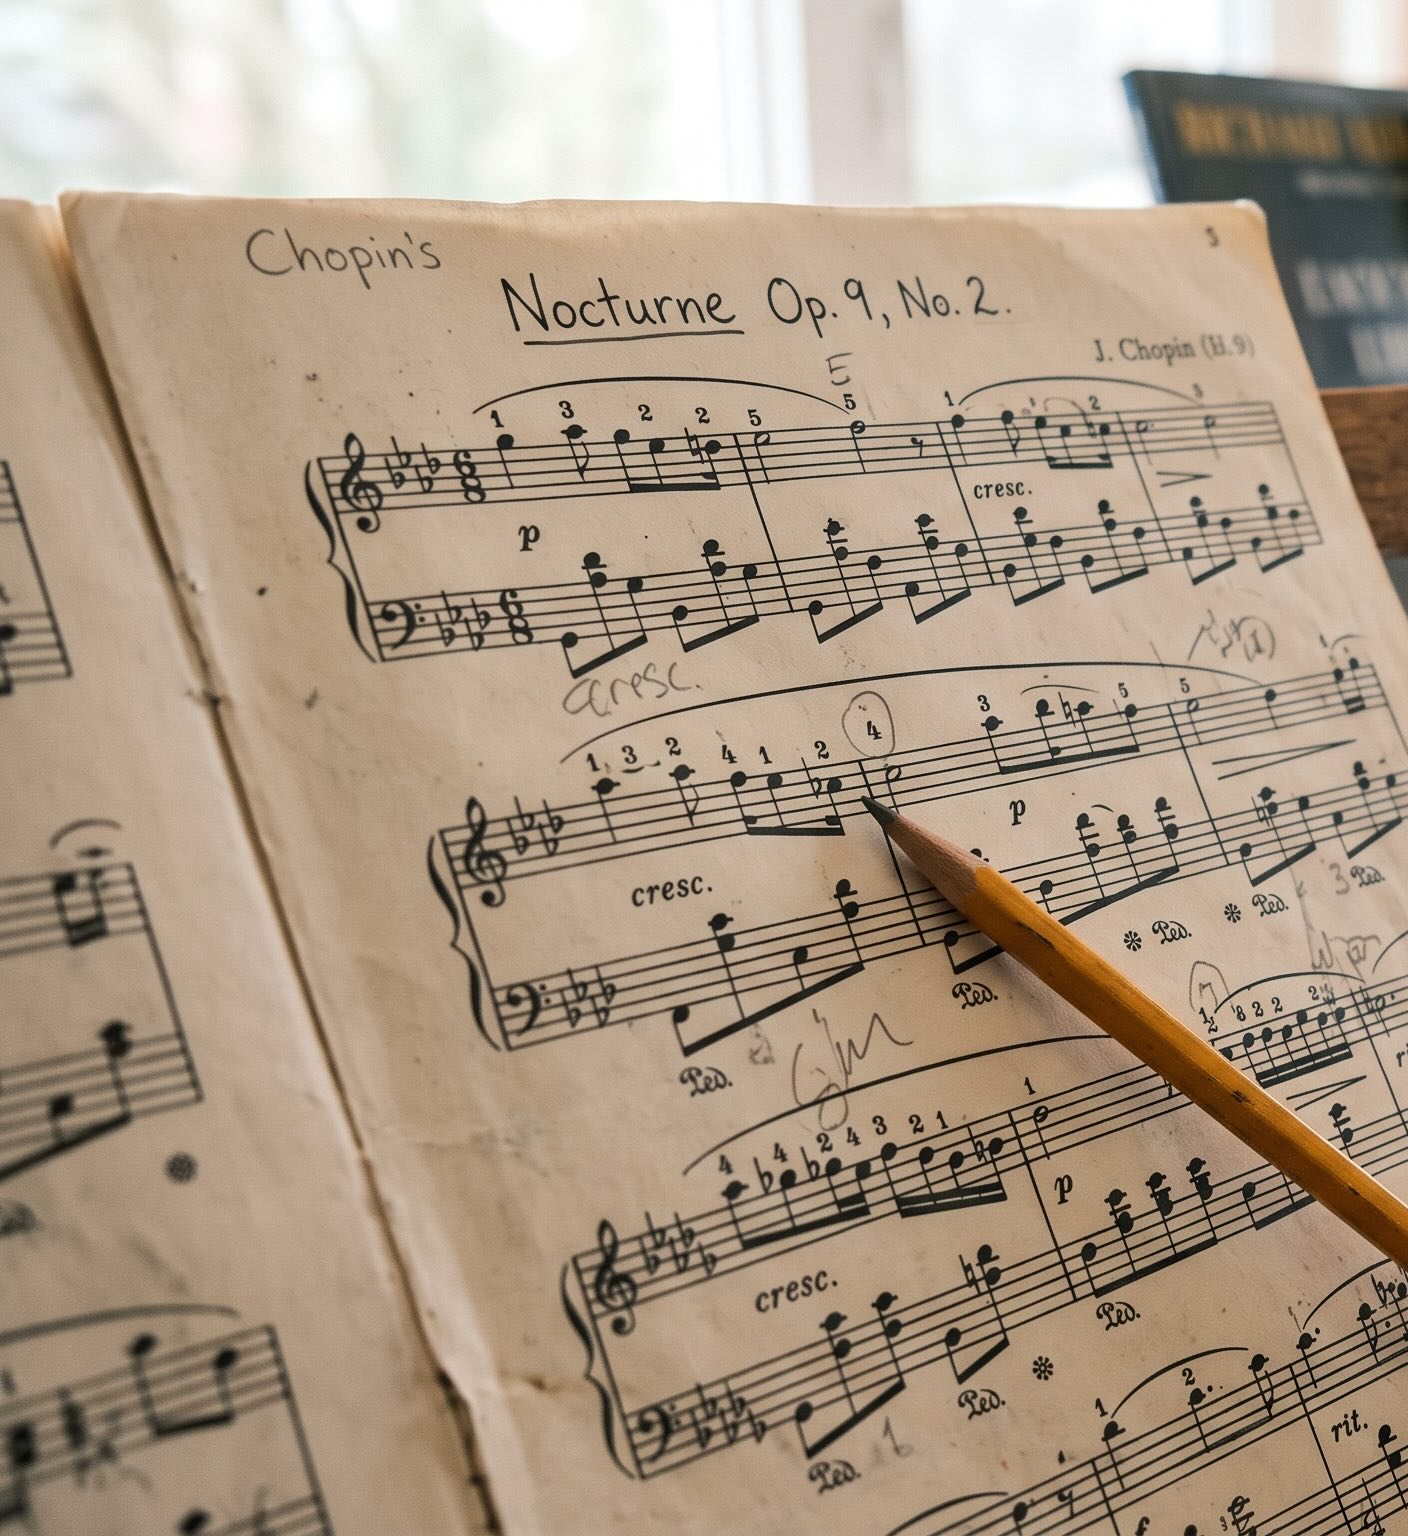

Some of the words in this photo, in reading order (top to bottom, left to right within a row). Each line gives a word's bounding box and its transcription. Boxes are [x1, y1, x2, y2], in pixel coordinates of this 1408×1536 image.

[246, 228, 442, 291] Chopin's
[500, 272, 737, 332] Nocturne
[767, 277, 838, 338] Op.
[843, 278, 890, 329] 9,
[896, 275, 960, 319] No.
[966, 275, 1012, 316] 2.
[1093, 339, 1114, 362] J.
[1118, 335, 1198, 367] Chopin
[490, 410, 505, 428] 1
[558, 400, 575, 419] 3
[637, 404, 653, 422] 2
[695, 407, 710, 424] 2
[747, 409, 762, 427] 5
[843, 393, 857, 410] 5
[944, 391, 955, 407] 1
[1089, 396, 1101, 410] 2
[973, 481, 1034, 500] cresc.
[518, 524, 542, 552] p
[586, 752, 601, 773] 1
[621, 744, 638, 764] 3
[665, 736, 682, 757] 2
[721, 744, 739, 764] 4
[758, 745, 773, 765] 1
[814, 740, 830, 760] 2
[866, 720, 883, 741] 4
[977, 694, 992, 713] 3
[1117, 681, 1130, 699] 5
[1179, 677, 1191, 694] 5
[1009, 798, 1027, 827] p
[630, 874, 714, 908] cresc.
[1252, 1000, 1264, 1018] 2
[1271, 996, 1284, 1014] 2
[718, 1154, 734, 1176] 4
[773, 1142, 789, 1164] 4
[816, 1132, 833, 1153] 2
[846, 1126, 862, 1147] 4
[872, 1115, 888, 1136] 3
[908, 1114, 925, 1135] 2
[936, 1110, 949, 1130] 1
[1023, 1076, 1037, 1096] 1
[1053, 1171, 1074, 1205] p
[754, 1267, 839, 1315] cresc.
[1093, 1397, 1109, 1418] 1
[1181, 1367, 1196, 1387] 2
[1330, 1410, 1370, 1443] rit.
